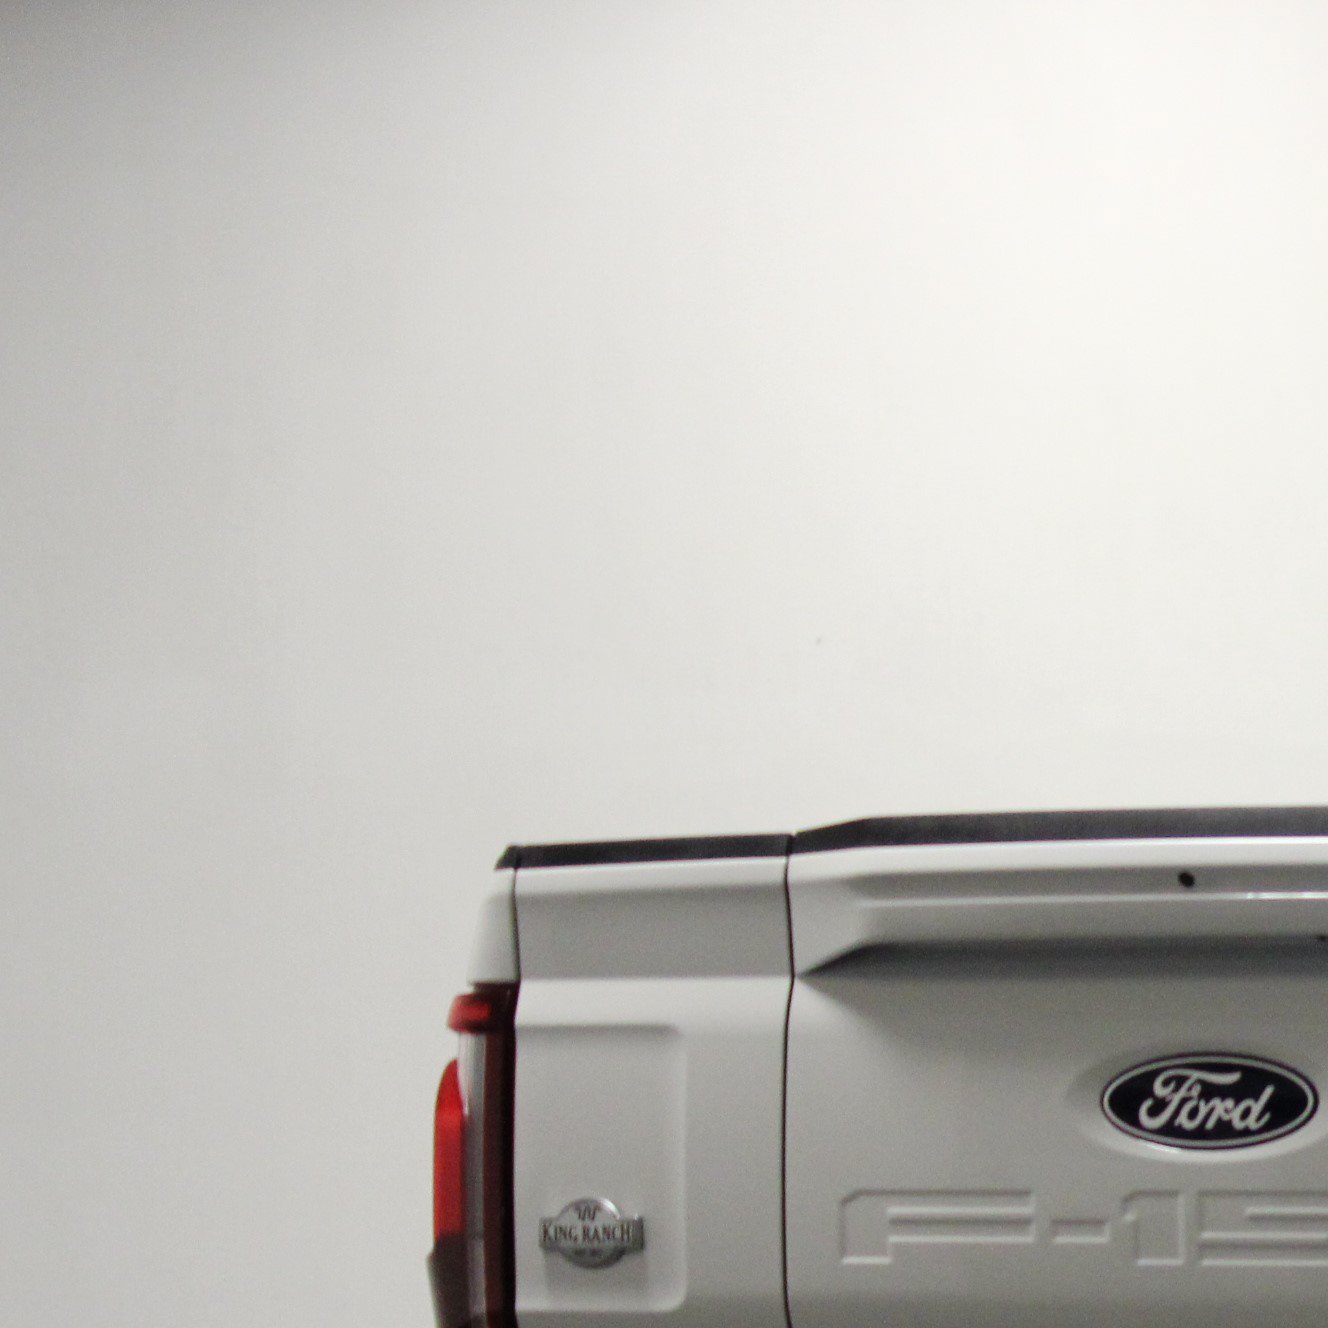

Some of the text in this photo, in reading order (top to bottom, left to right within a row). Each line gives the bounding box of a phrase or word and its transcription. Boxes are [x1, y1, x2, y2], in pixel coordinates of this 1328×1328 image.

[1139, 1066, 1276, 1134] Ford
[543, 1222, 631, 1242] KING RANCH
